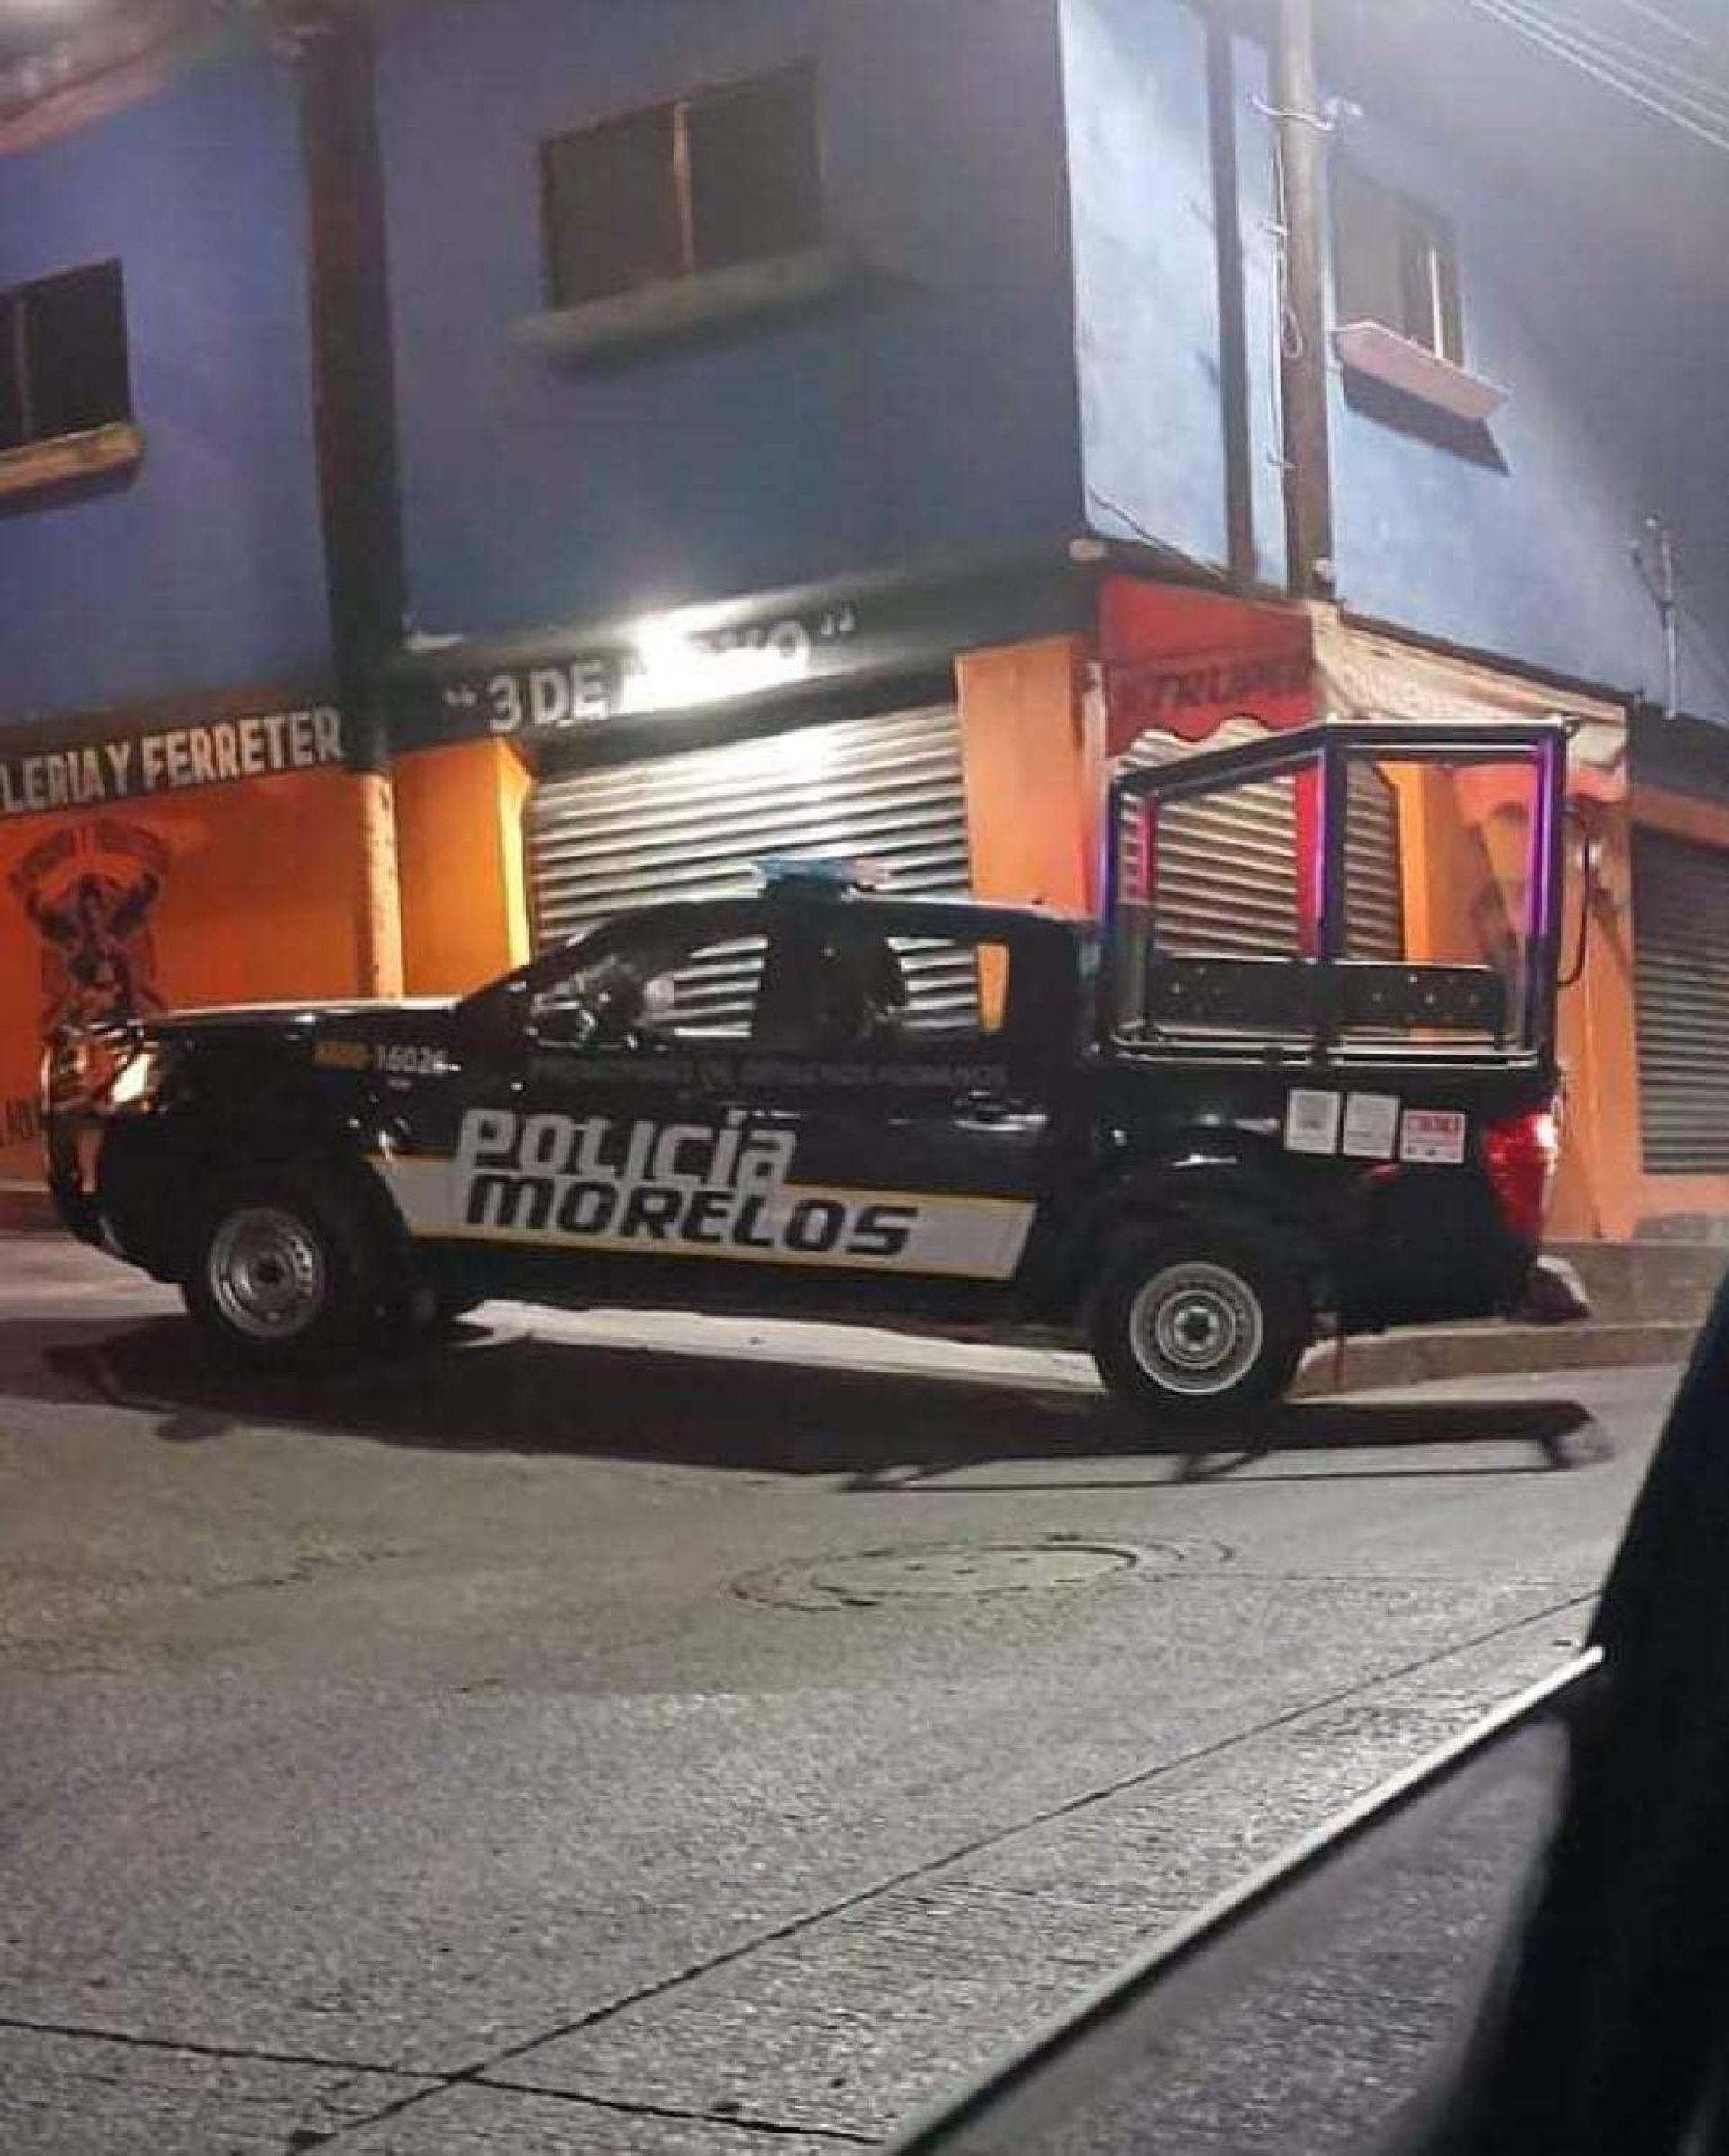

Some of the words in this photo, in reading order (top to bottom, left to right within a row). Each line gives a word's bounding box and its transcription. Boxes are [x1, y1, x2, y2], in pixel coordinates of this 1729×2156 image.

[530, 659, 610, 727] DE
[105, 738, 132, 795] Y
[141, 705, 344, 789] FERRETER
[466, 1173, 918, 1257] MORELOS
